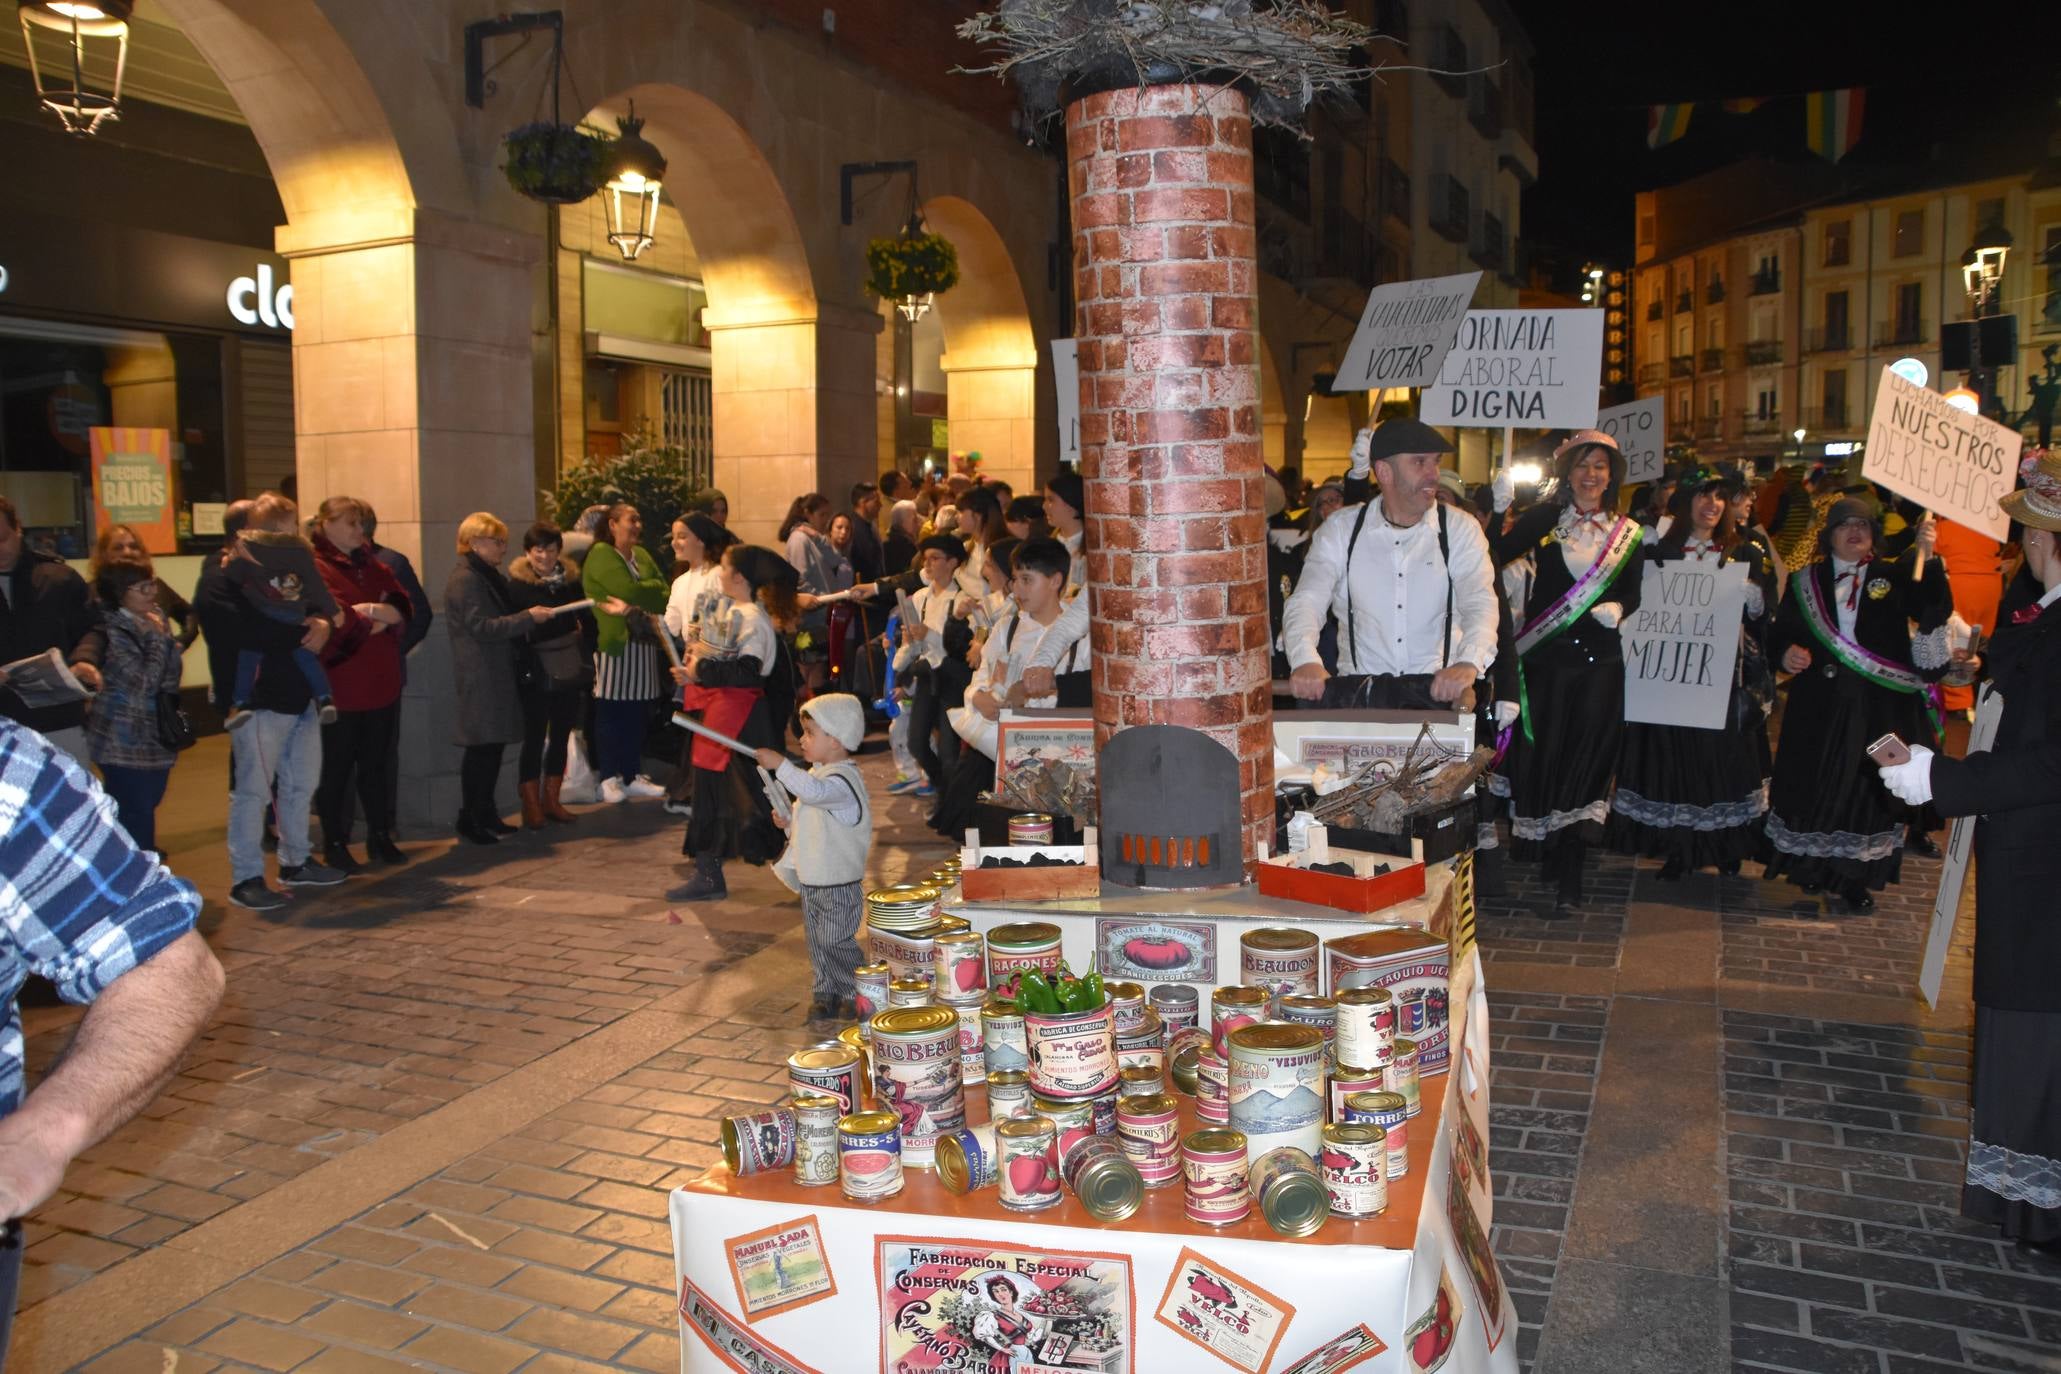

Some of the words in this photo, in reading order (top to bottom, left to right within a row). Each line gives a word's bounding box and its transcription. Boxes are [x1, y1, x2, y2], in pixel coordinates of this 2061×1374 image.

[1365, 343, 1434, 380] VOTAR
[1441, 356, 1564, 387] LABORAL
[1451, 390, 1546, 420] DIGNA
[1891, 398, 2005, 476] NUESTROS
[1871, 422, 2005, 521] DERECHOS
[103, 481, 164, 507] BAJOS
[1659, 571, 1716, 607] VOTO
[1636, 610, 1683, 634] PARA
[1693, 612, 1716, 637] LA
[1624, 639, 1714, 687] MUJER
[1290, 1016, 1334, 1025] MURO
[813, 1076, 840, 1092] PELADO
[1323, 1170, 1380, 1185] VELCO
[734, 1238, 778, 1259] MANUEL
[778, 1228, 809, 1248] SADA
[909, 1248, 1007, 1270] FABRICACION
[1015, 1257, 1101, 1282] ESPECIAL
[894, 1268, 980, 1296] CONSERVAS
[1191, 1293, 1249, 1335] VELCO
